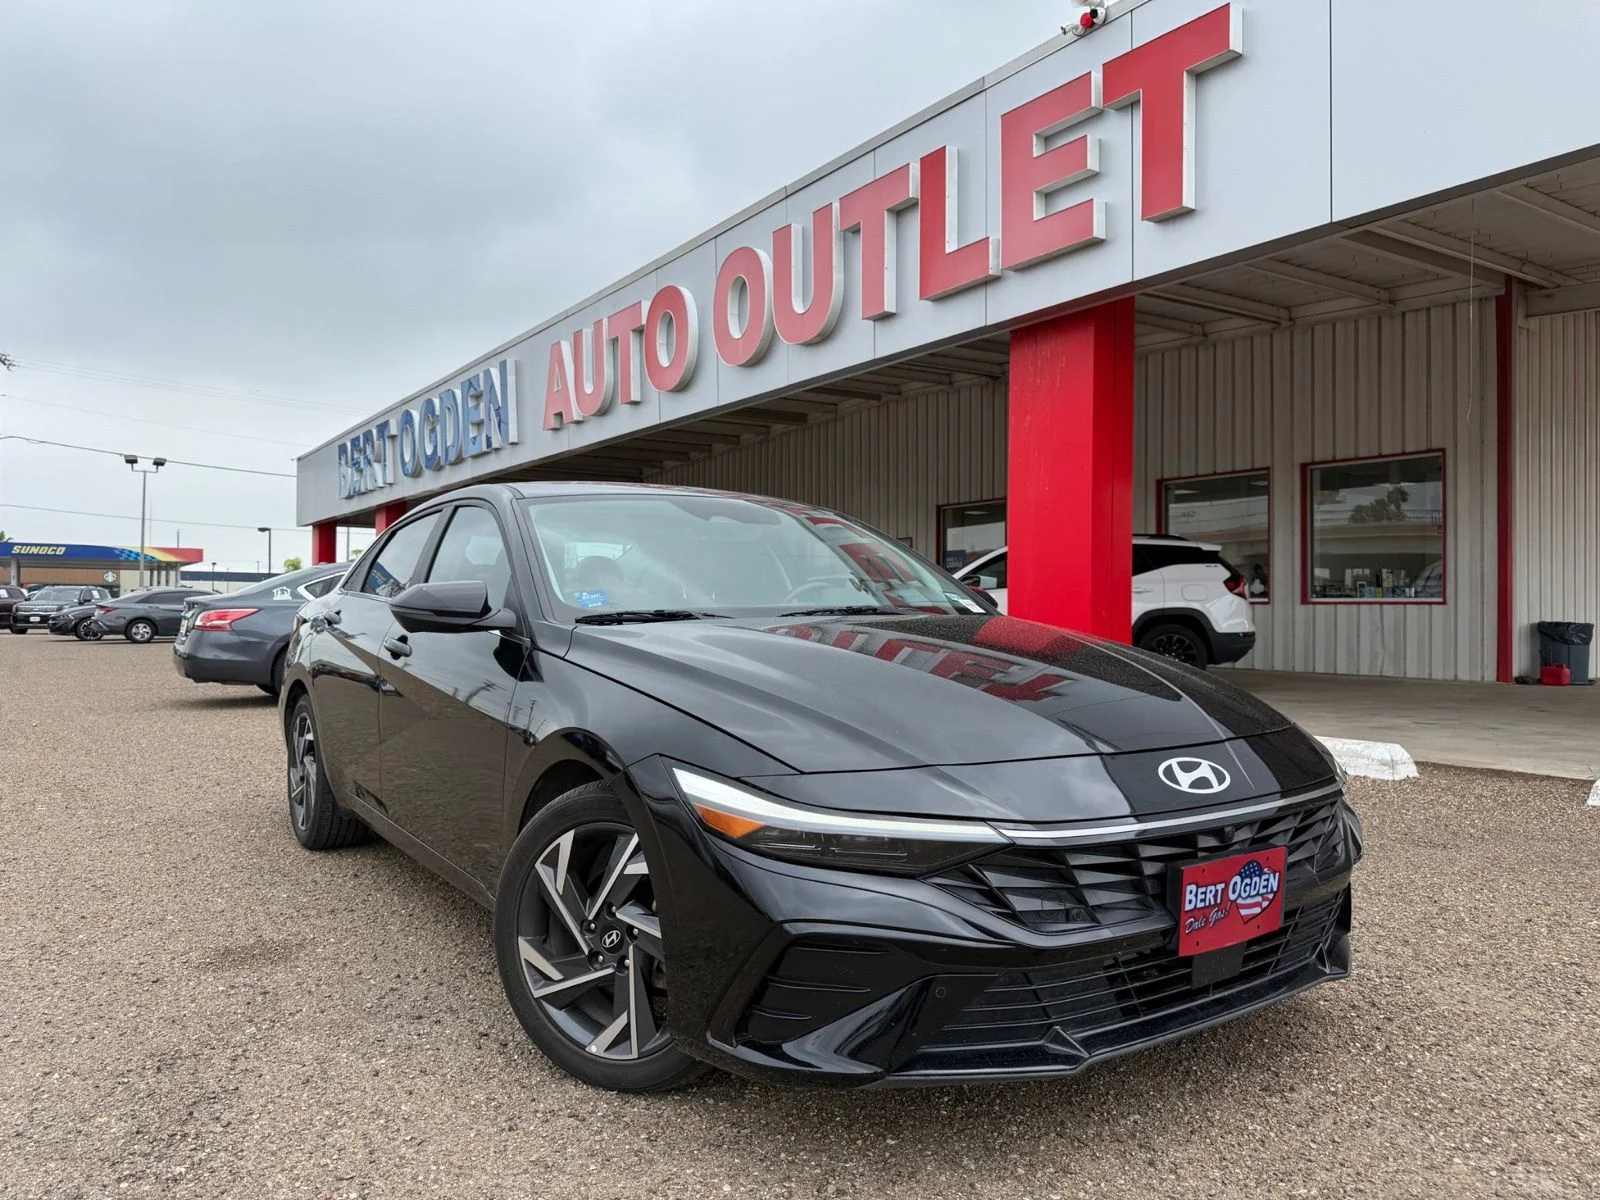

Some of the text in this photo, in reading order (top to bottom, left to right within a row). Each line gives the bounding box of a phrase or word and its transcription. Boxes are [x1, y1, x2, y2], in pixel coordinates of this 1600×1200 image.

[337, 2, 1243, 500] BERT OGDEN AUTO OUTLET
[11, 545, 67, 555] SUNOCO
[1184, 872, 1280, 912] BERT OGDEN
